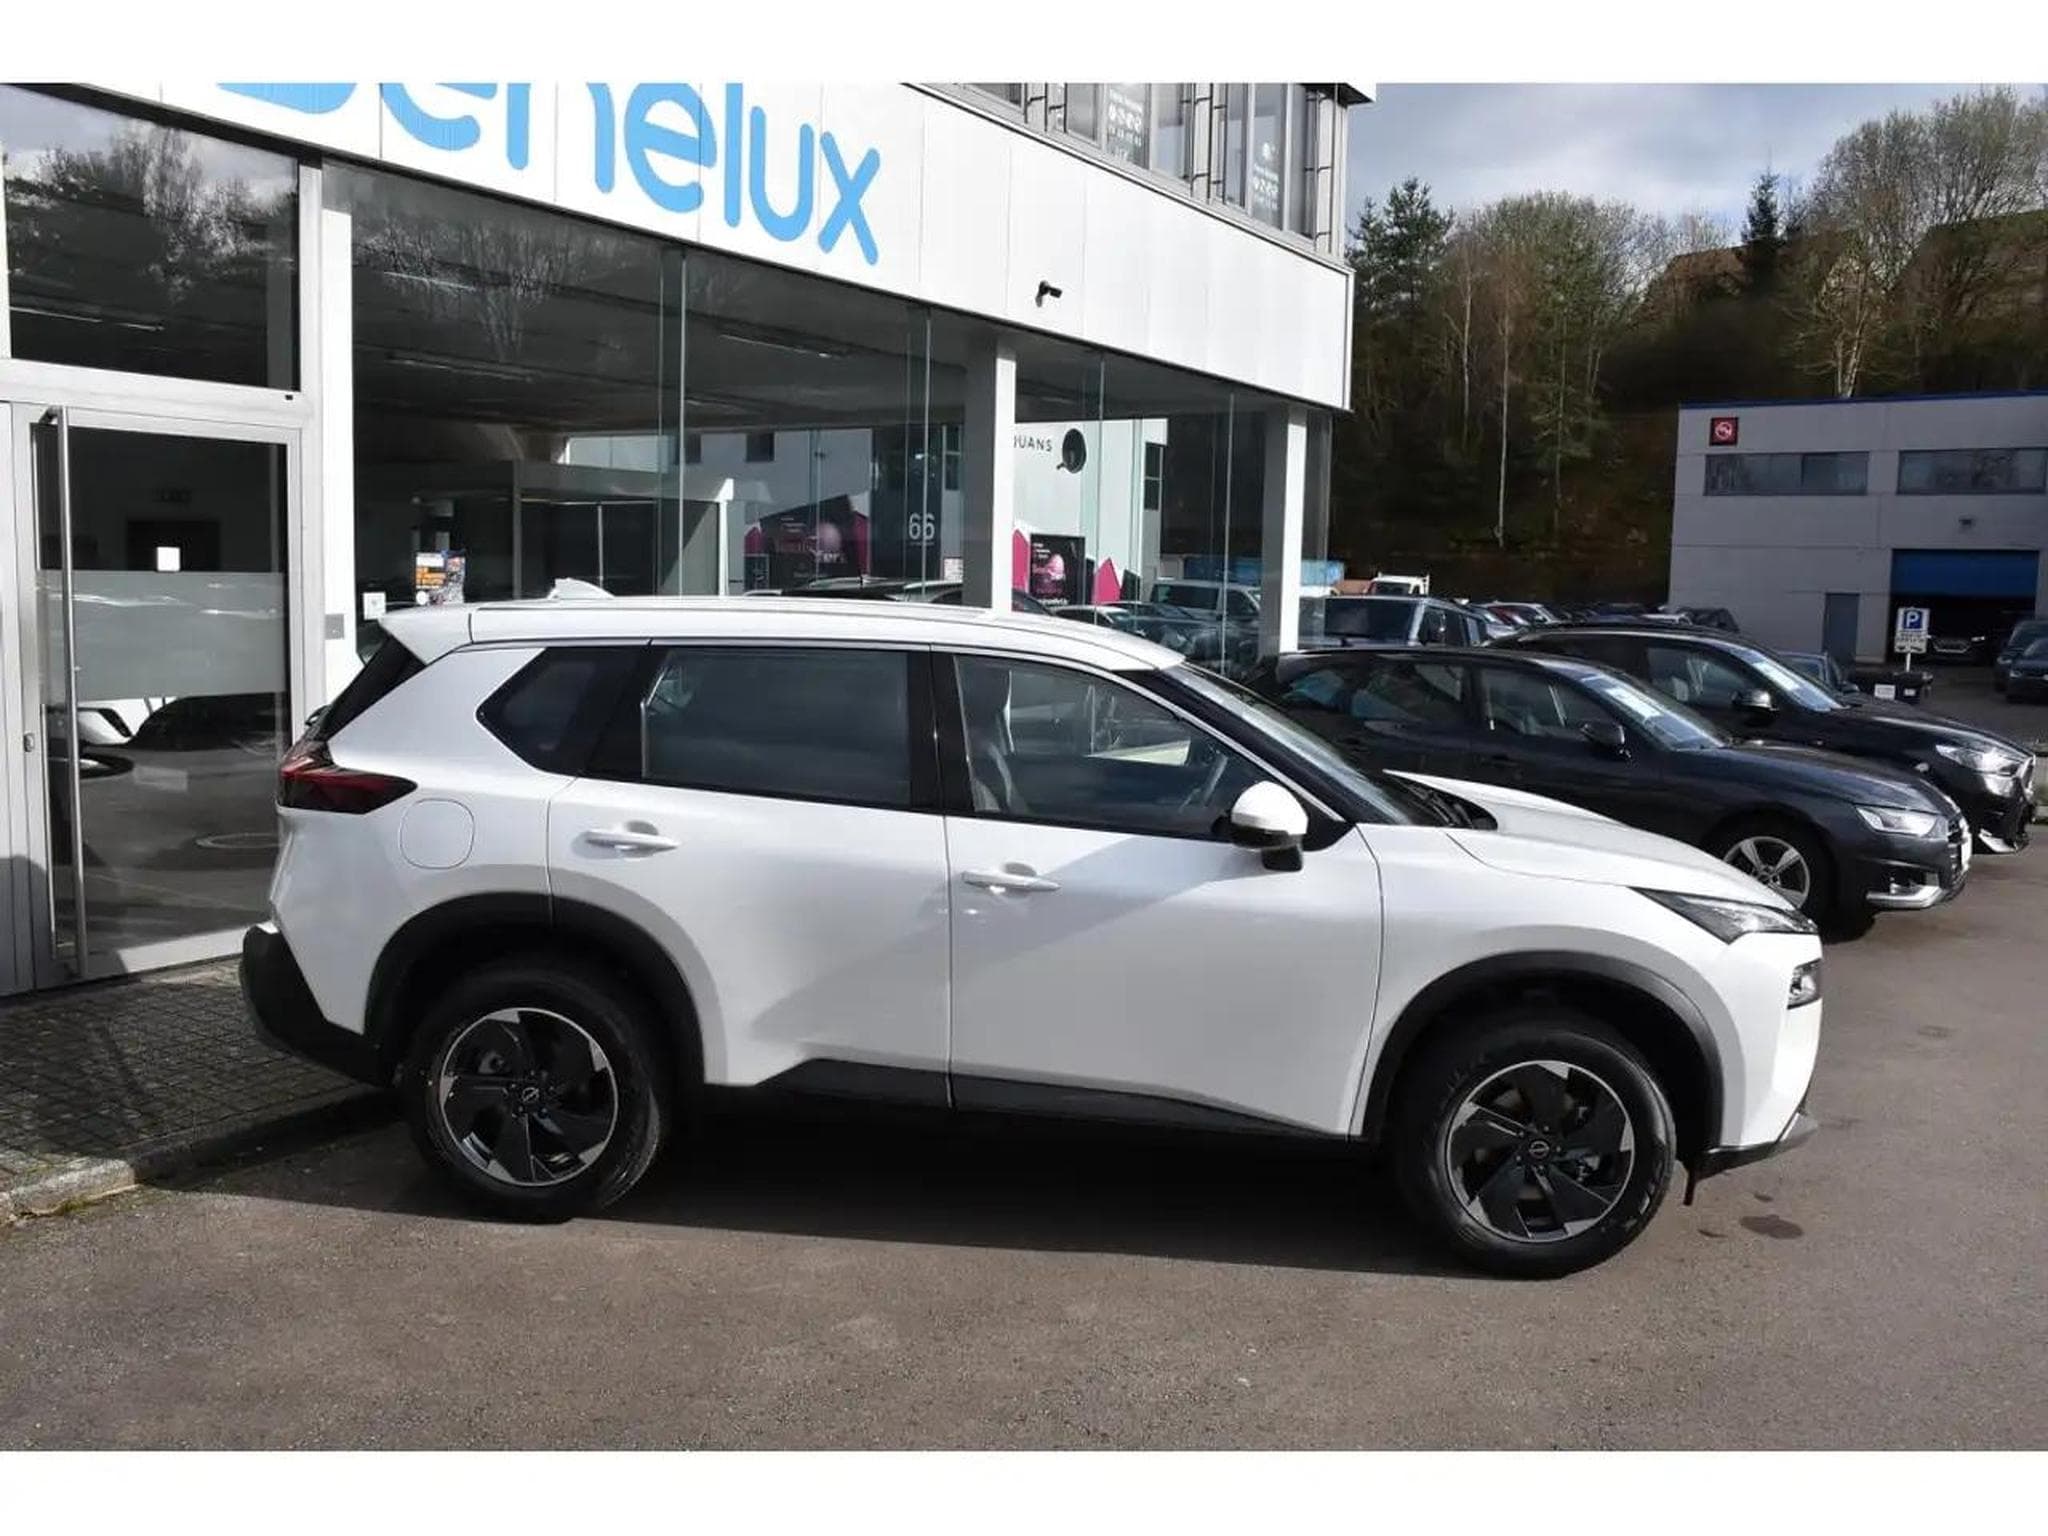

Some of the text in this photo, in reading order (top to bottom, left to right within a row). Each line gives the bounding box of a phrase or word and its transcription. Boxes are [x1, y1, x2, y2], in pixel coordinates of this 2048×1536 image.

[1013, 434, 1054, 452] UANS
[908, 512, 936, 541] 66
[1906, 611, 1920, 628] P
